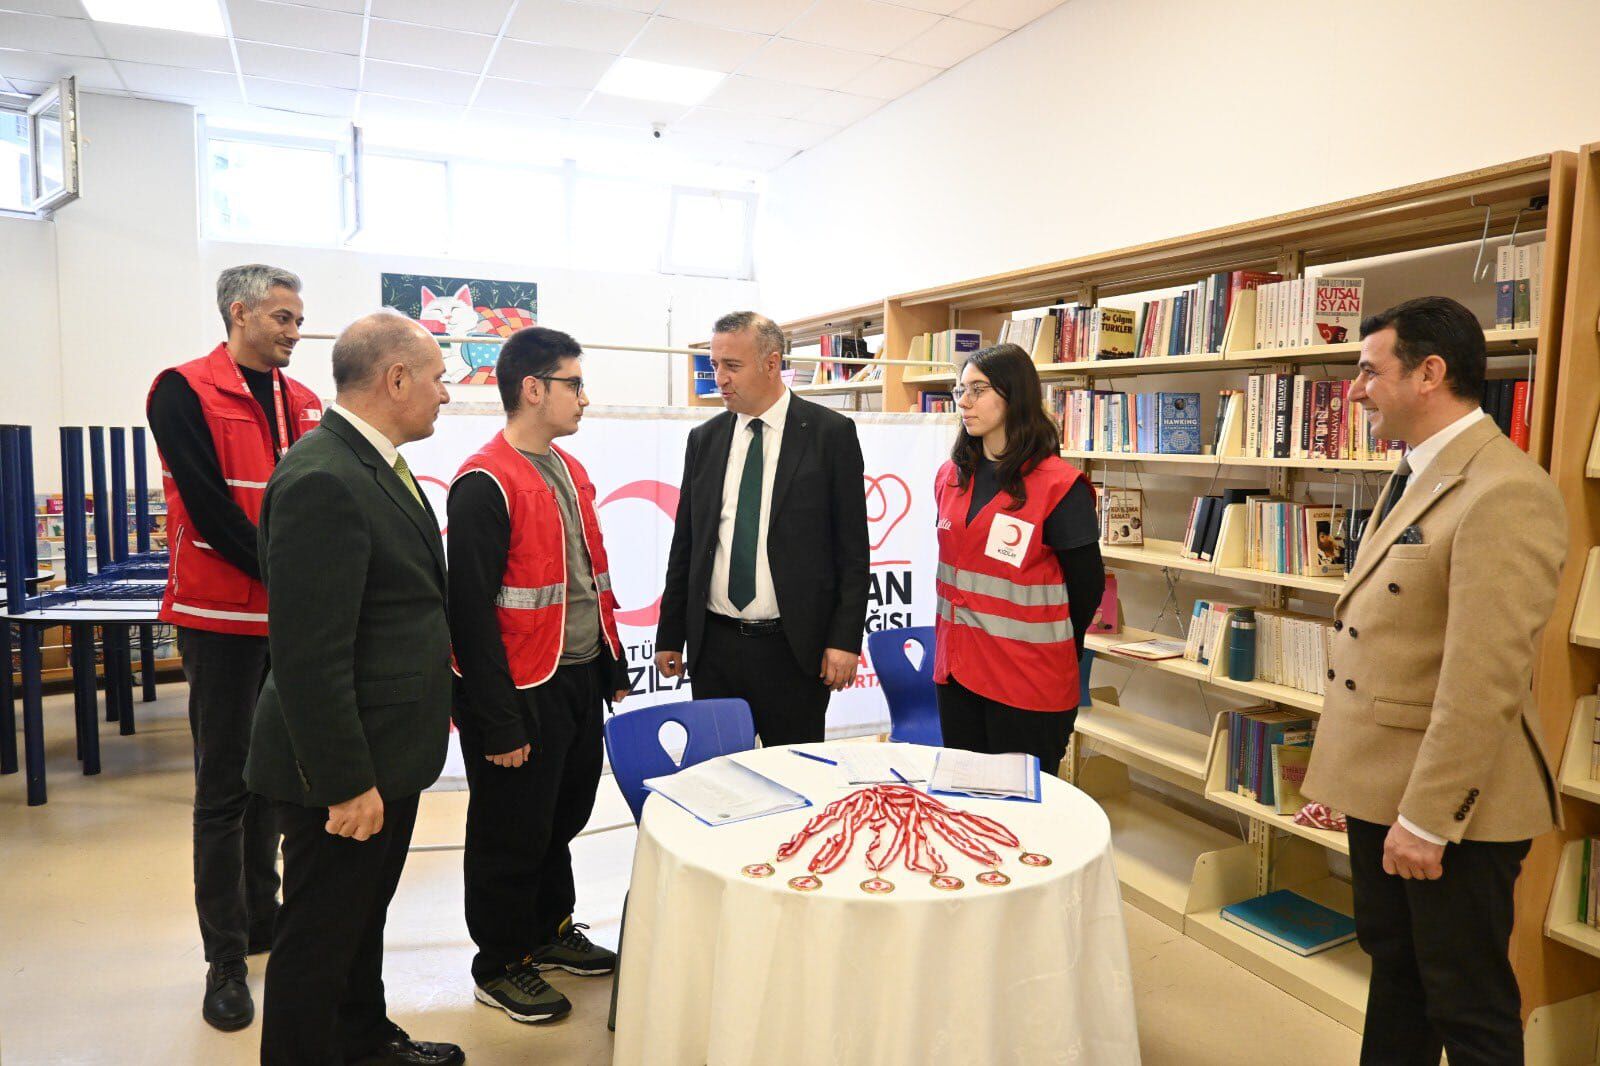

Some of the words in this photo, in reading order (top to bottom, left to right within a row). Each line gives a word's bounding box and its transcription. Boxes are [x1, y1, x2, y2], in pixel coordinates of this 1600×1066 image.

[1317, 287, 1360, 300] KUTSAL
[1276, 415, 1284, 444] NUTUK
[1314, 410, 1329, 453] NUTUK
[867, 570, 912, 606] AN
[627, 640, 653, 661] TÜ
[627, 662, 691, 696] ZILA
